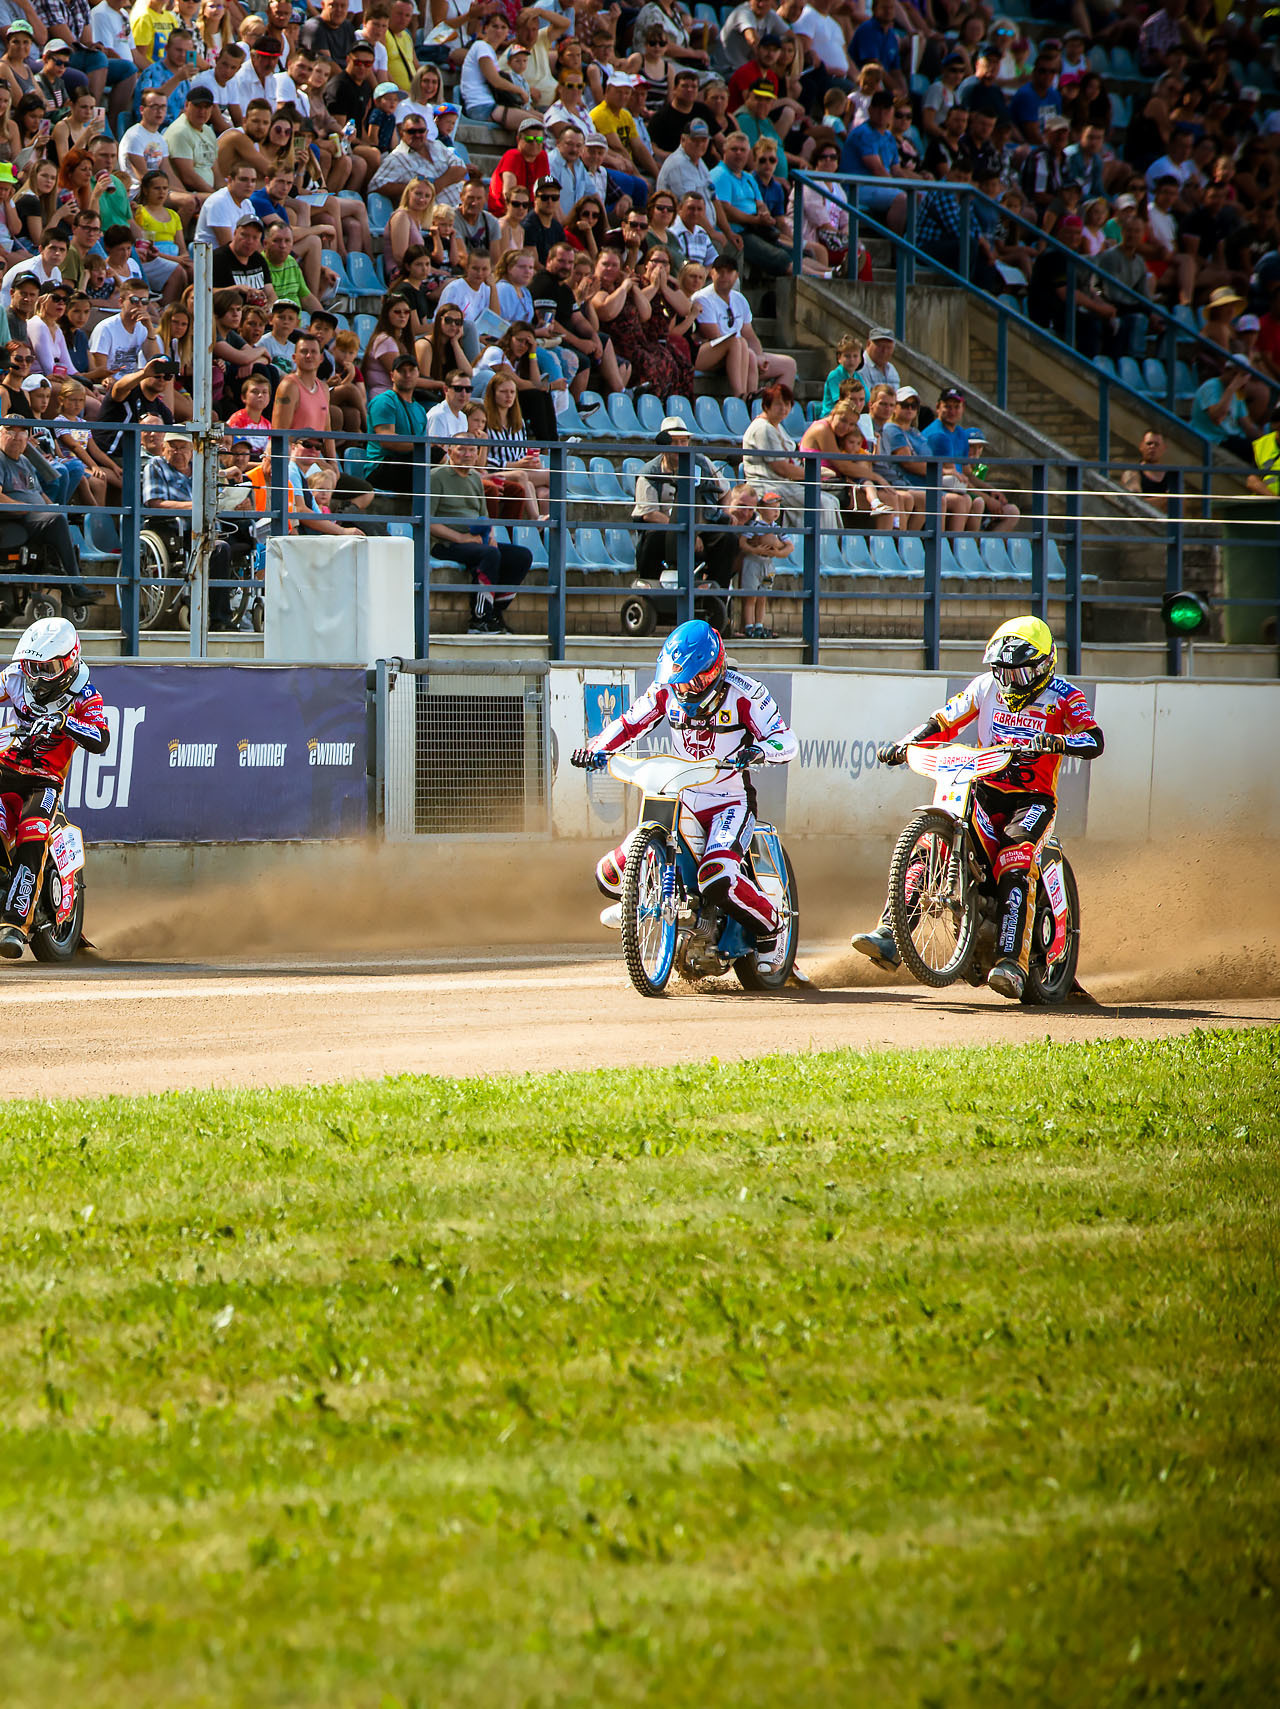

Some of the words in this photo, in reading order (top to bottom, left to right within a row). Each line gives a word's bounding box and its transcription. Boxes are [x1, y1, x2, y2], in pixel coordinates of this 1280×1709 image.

[993, 712, 1044, 732] ABRAMCZYK
[169, 743, 218, 767] ewinner
[239, 743, 287, 767] ewinner
[308, 742, 356, 766] ewinner
[1004, 908, 1019, 952] HYUNDAI
